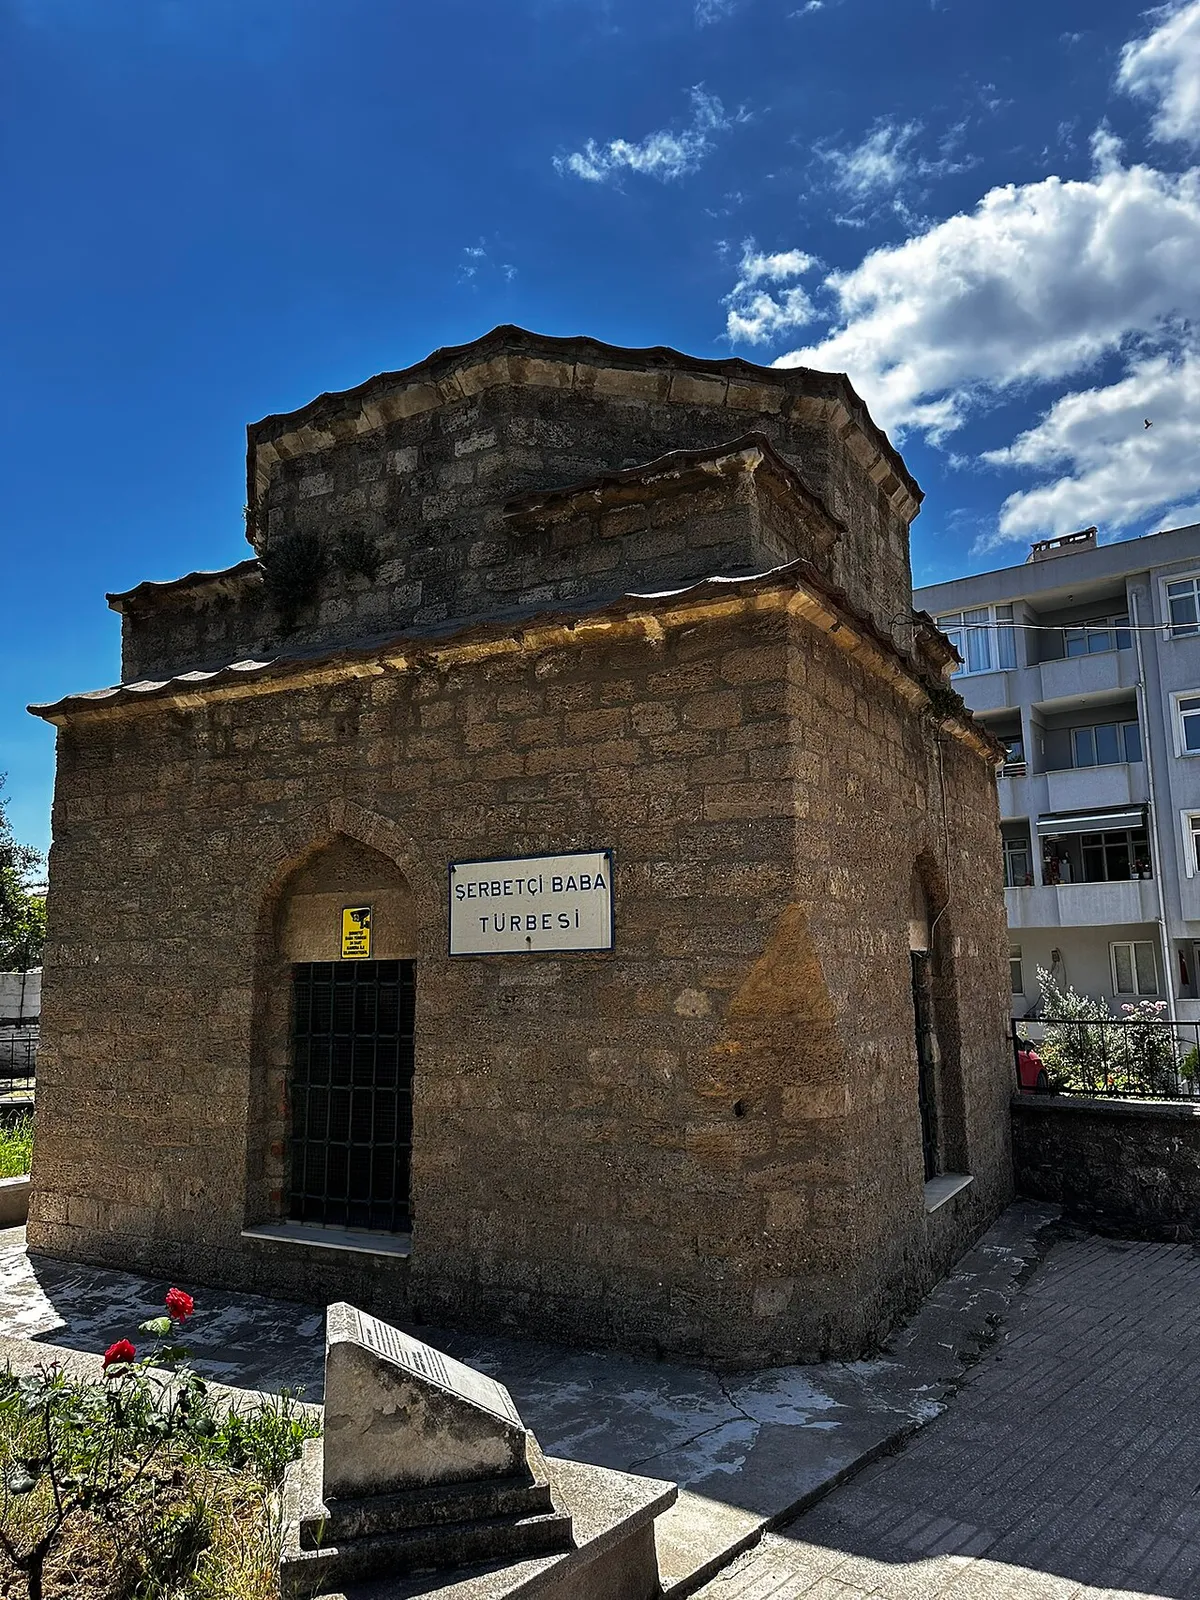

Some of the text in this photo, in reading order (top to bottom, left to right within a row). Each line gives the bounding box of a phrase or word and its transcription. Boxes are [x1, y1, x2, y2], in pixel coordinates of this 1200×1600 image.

[455, 873, 606, 901] ŞERBETÇİ BABA
[479, 909, 580, 933] TÜRBESİ
